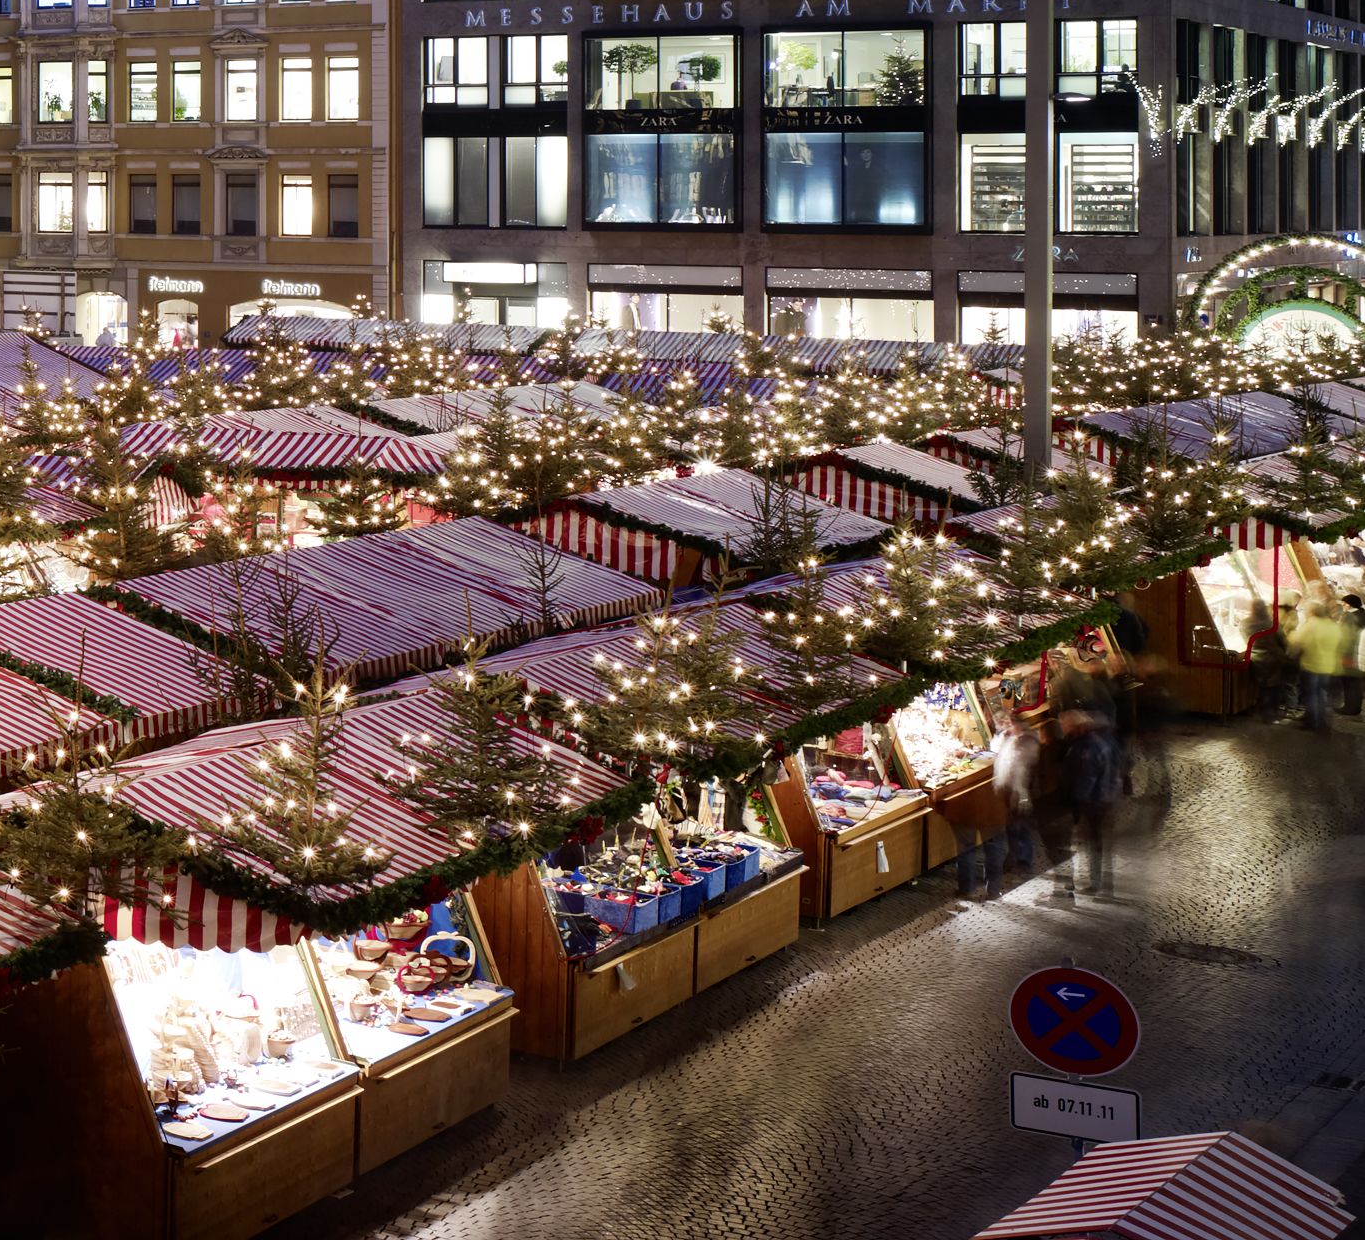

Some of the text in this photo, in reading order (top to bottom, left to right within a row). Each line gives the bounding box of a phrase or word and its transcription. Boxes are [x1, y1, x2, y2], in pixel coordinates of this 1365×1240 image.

[465, 0, 734, 28] MESSEHAUS
[640, 116, 678, 127] ZARA
[823, 114, 864, 125] ZARA
[1010, 246, 1080, 262] ZRA
[1033, 1094, 1049, 1109] ab
